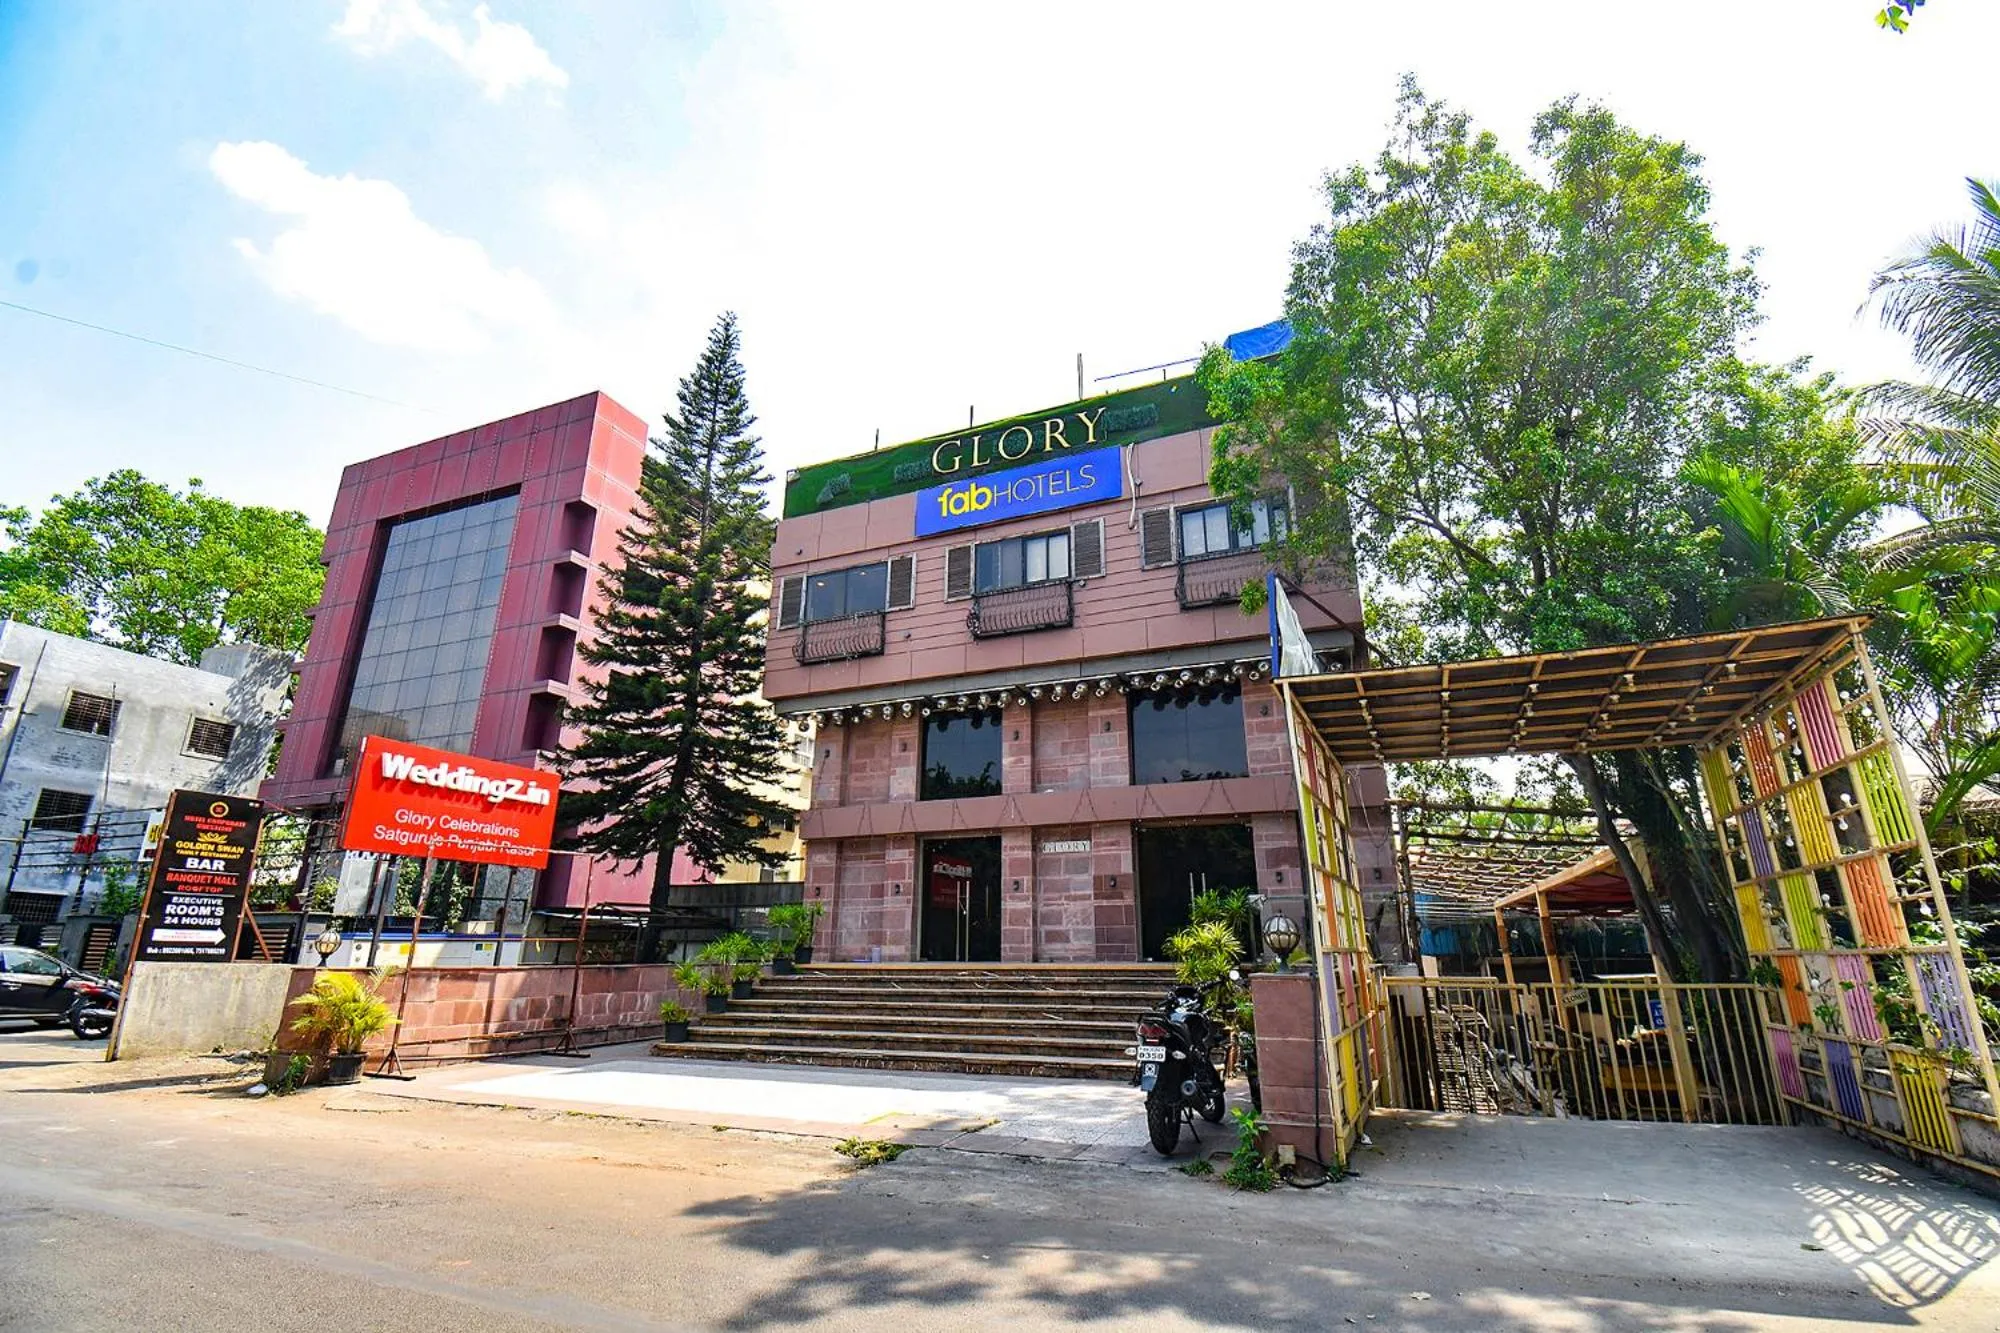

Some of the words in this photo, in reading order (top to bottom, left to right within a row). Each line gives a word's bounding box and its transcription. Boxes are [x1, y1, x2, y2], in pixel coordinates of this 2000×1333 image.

[932, 407, 1106, 473] GLORY
[938, 464, 1096, 517] fabHOTELS
[382, 752, 550, 805] WeddingZ.in
[395, 808, 436, 830] Glory
[439, 815, 520, 838] Celebrations
[175, 840, 215, 852] GOLDEN
[217, 844, 244, 854] SWAN
[373, 825, 444, 847] Satguru's
[448, 834, 498, 855] Punjabi
[199, 851, 240, 860] RESTAURANT
[186, 857, 226, 871] BAR
[166, 872, 213, 884] BANQUET
[214, 876, 237, 886] HALL
[177, 884, 224, 893] ROOFTOP
[172, 896, 223, 906] EXECUTIVE
[165, 904, 224, 917] ROOM'S
[164, 916, 178, 925] 24
[180, 917, 222, 926] HOURS
